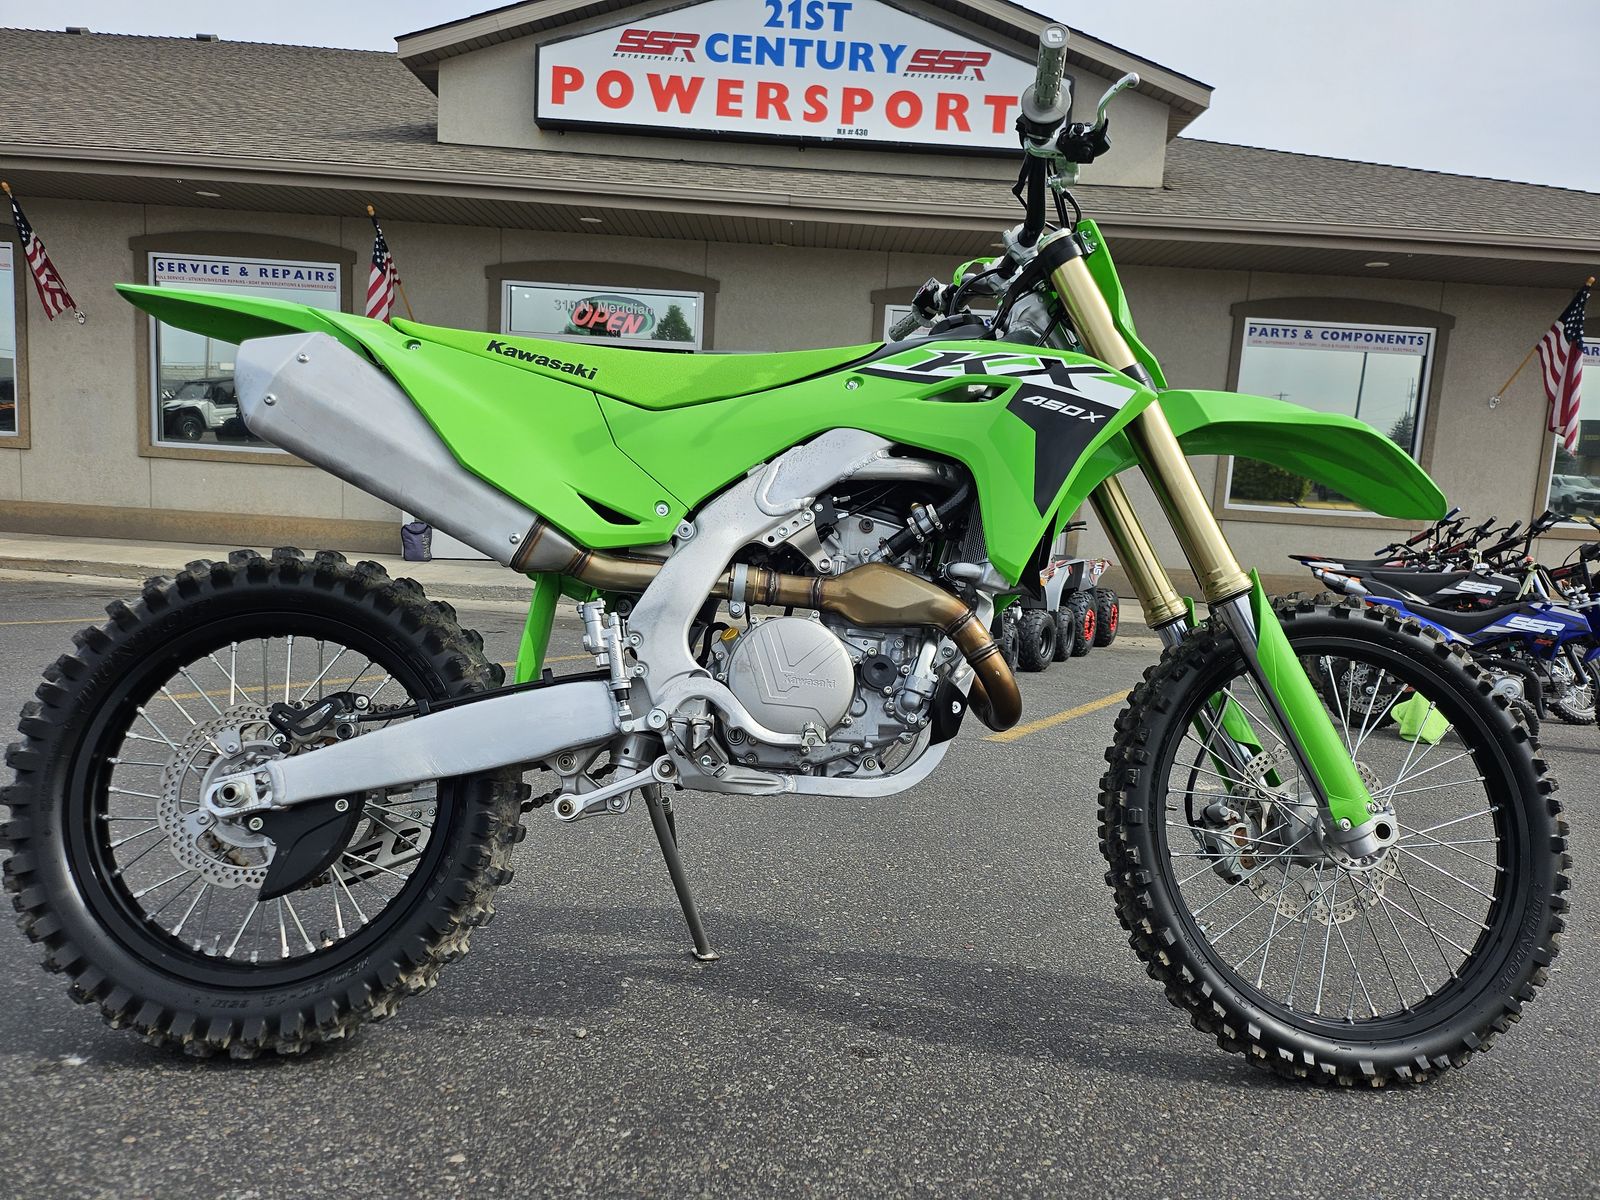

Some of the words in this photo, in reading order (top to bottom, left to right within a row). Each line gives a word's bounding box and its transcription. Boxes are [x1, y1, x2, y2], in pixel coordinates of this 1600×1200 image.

[764, 0, 853, 32] 21ST
[612, 52, 685, 62] MOTORSPORTS
[615, 29, 700, 62] SSR
[705, 33, 908, 73] CENTURY
[902, 72, 975, 81] MOTORSPORTS
[906, 48, 992, 81] SSR
[551, 65, 1019, 134] POWERSPORT
[157, 261, 230, 276] SERVICE
[239, 266, 249, 277] &
[259, 267, 335, 282] REPAIRS
[572, 304, 645, 335] OPEN
[598, 302, 654, 315] Meridian
[1249, 326, 1298, 339] PARTS
[1304, 329, 1313, 340] &
[1320, 330, 1424, 346] COMPONENTS
[486, 340, 598, 380] Kawasaki
[905, 350, 1114, 393] KX
[1505, 616, 1565, 636] SSR
[784, 673, 837, 689] Kawasaki
